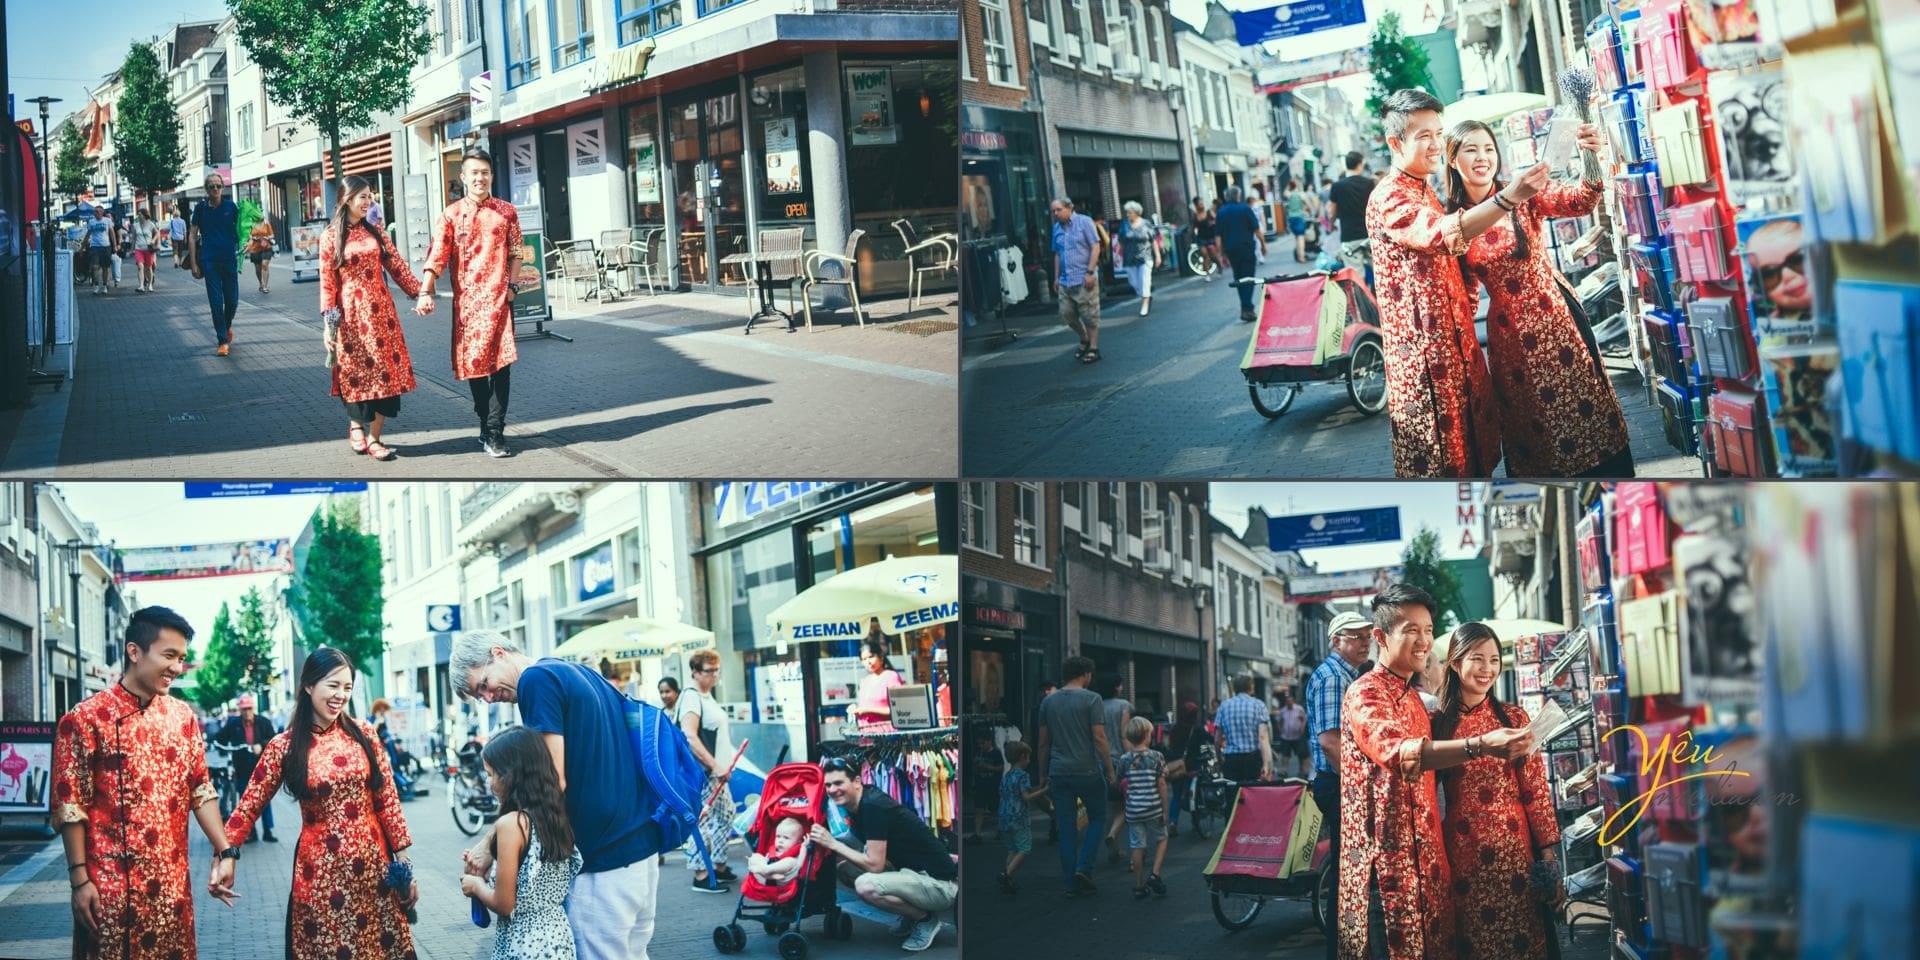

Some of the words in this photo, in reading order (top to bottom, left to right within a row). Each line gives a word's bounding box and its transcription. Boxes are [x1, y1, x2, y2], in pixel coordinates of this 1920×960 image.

[583, 37, 656, 92] SUBWAY
[785, 202, 808, 217] OPEN
[793, 622, 861, 639] ZEEMAN
[615, 648, 665, 659] ZEEMAN
